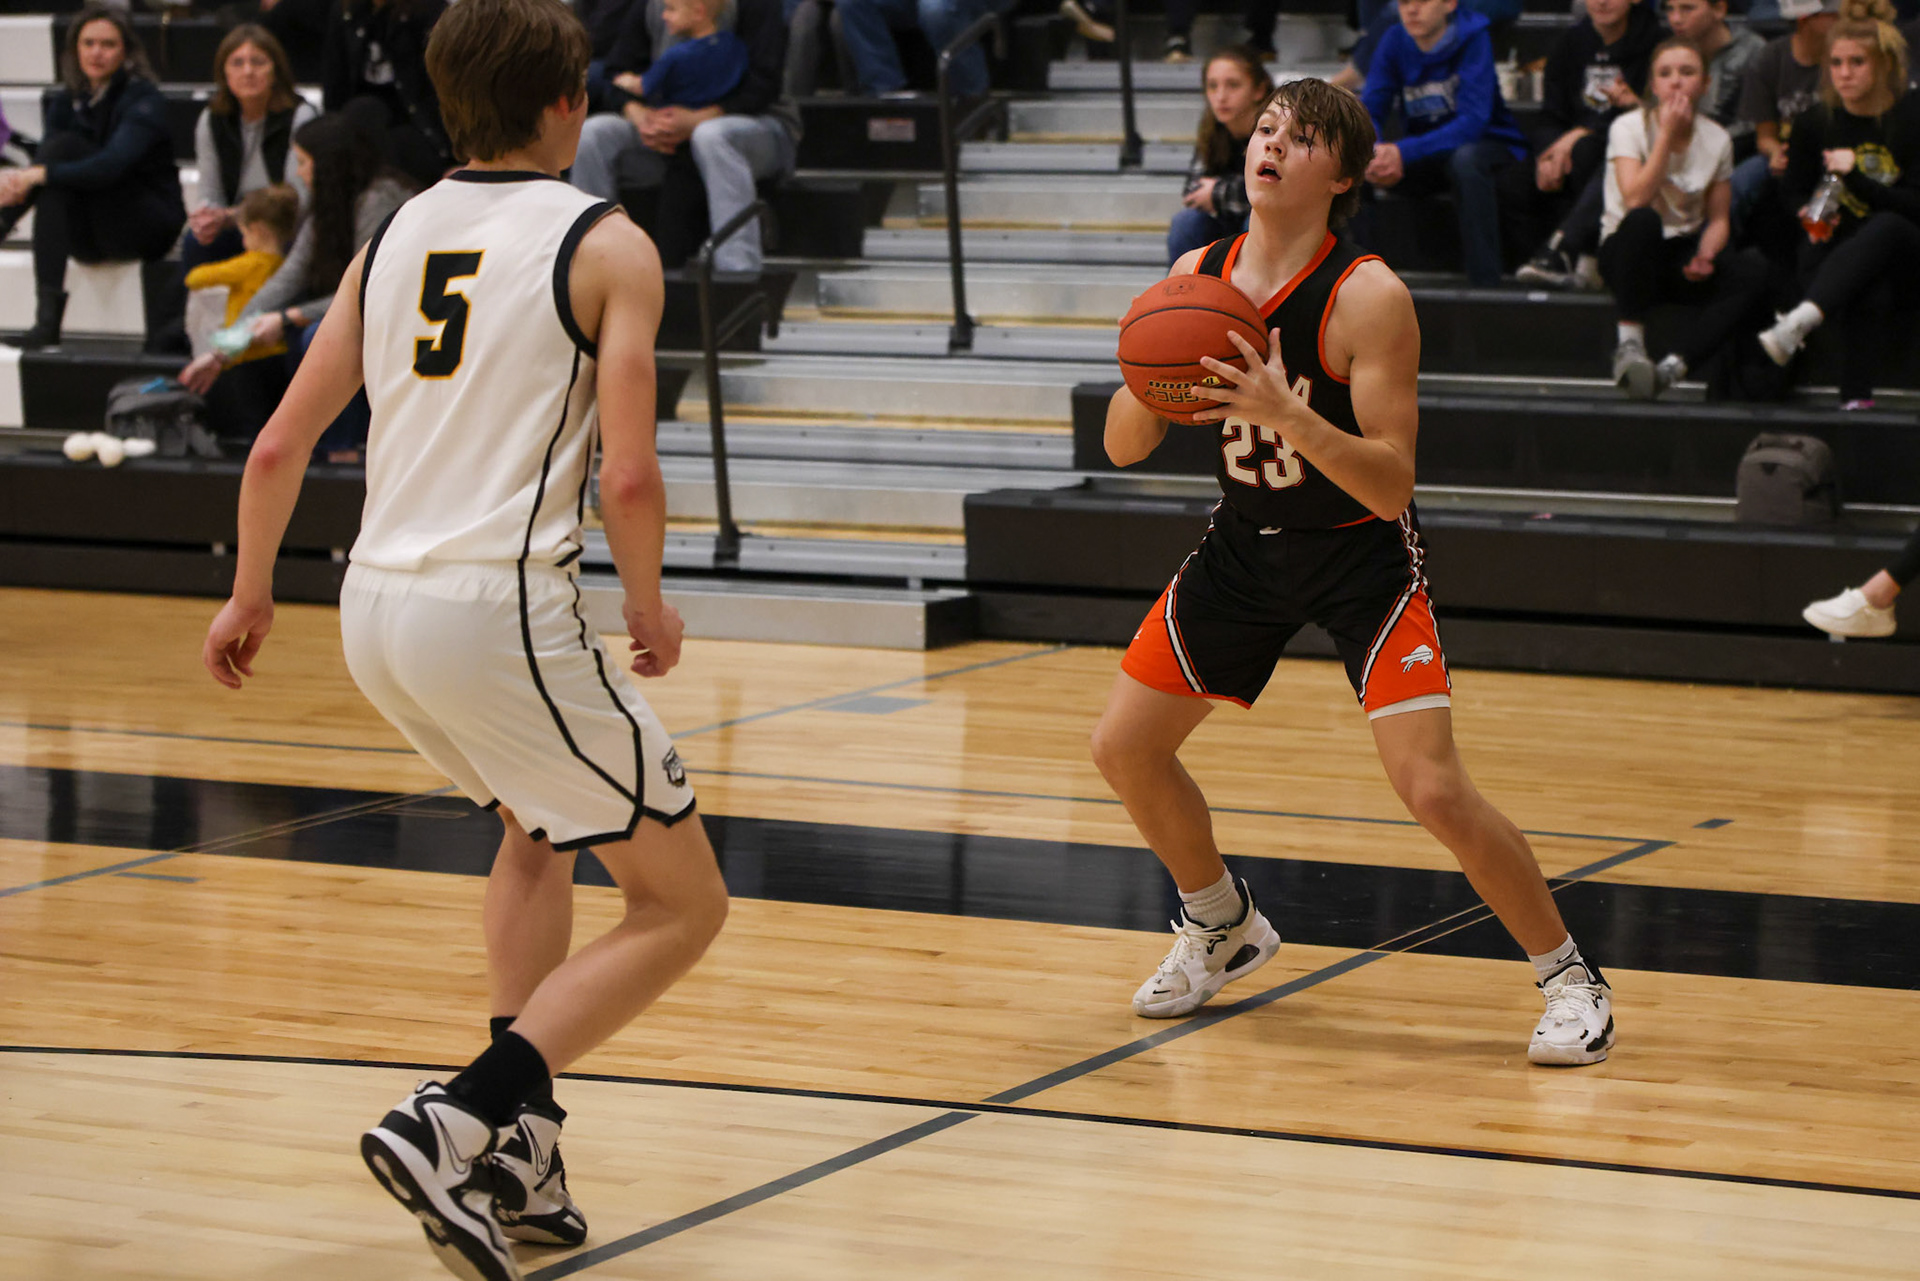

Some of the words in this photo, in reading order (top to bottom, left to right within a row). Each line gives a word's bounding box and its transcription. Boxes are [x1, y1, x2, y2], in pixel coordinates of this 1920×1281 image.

[412, 249, 486, 380] 5
[1144, 388, 1208, 404] GACY
[1221, 416, 1306, 491] 23
